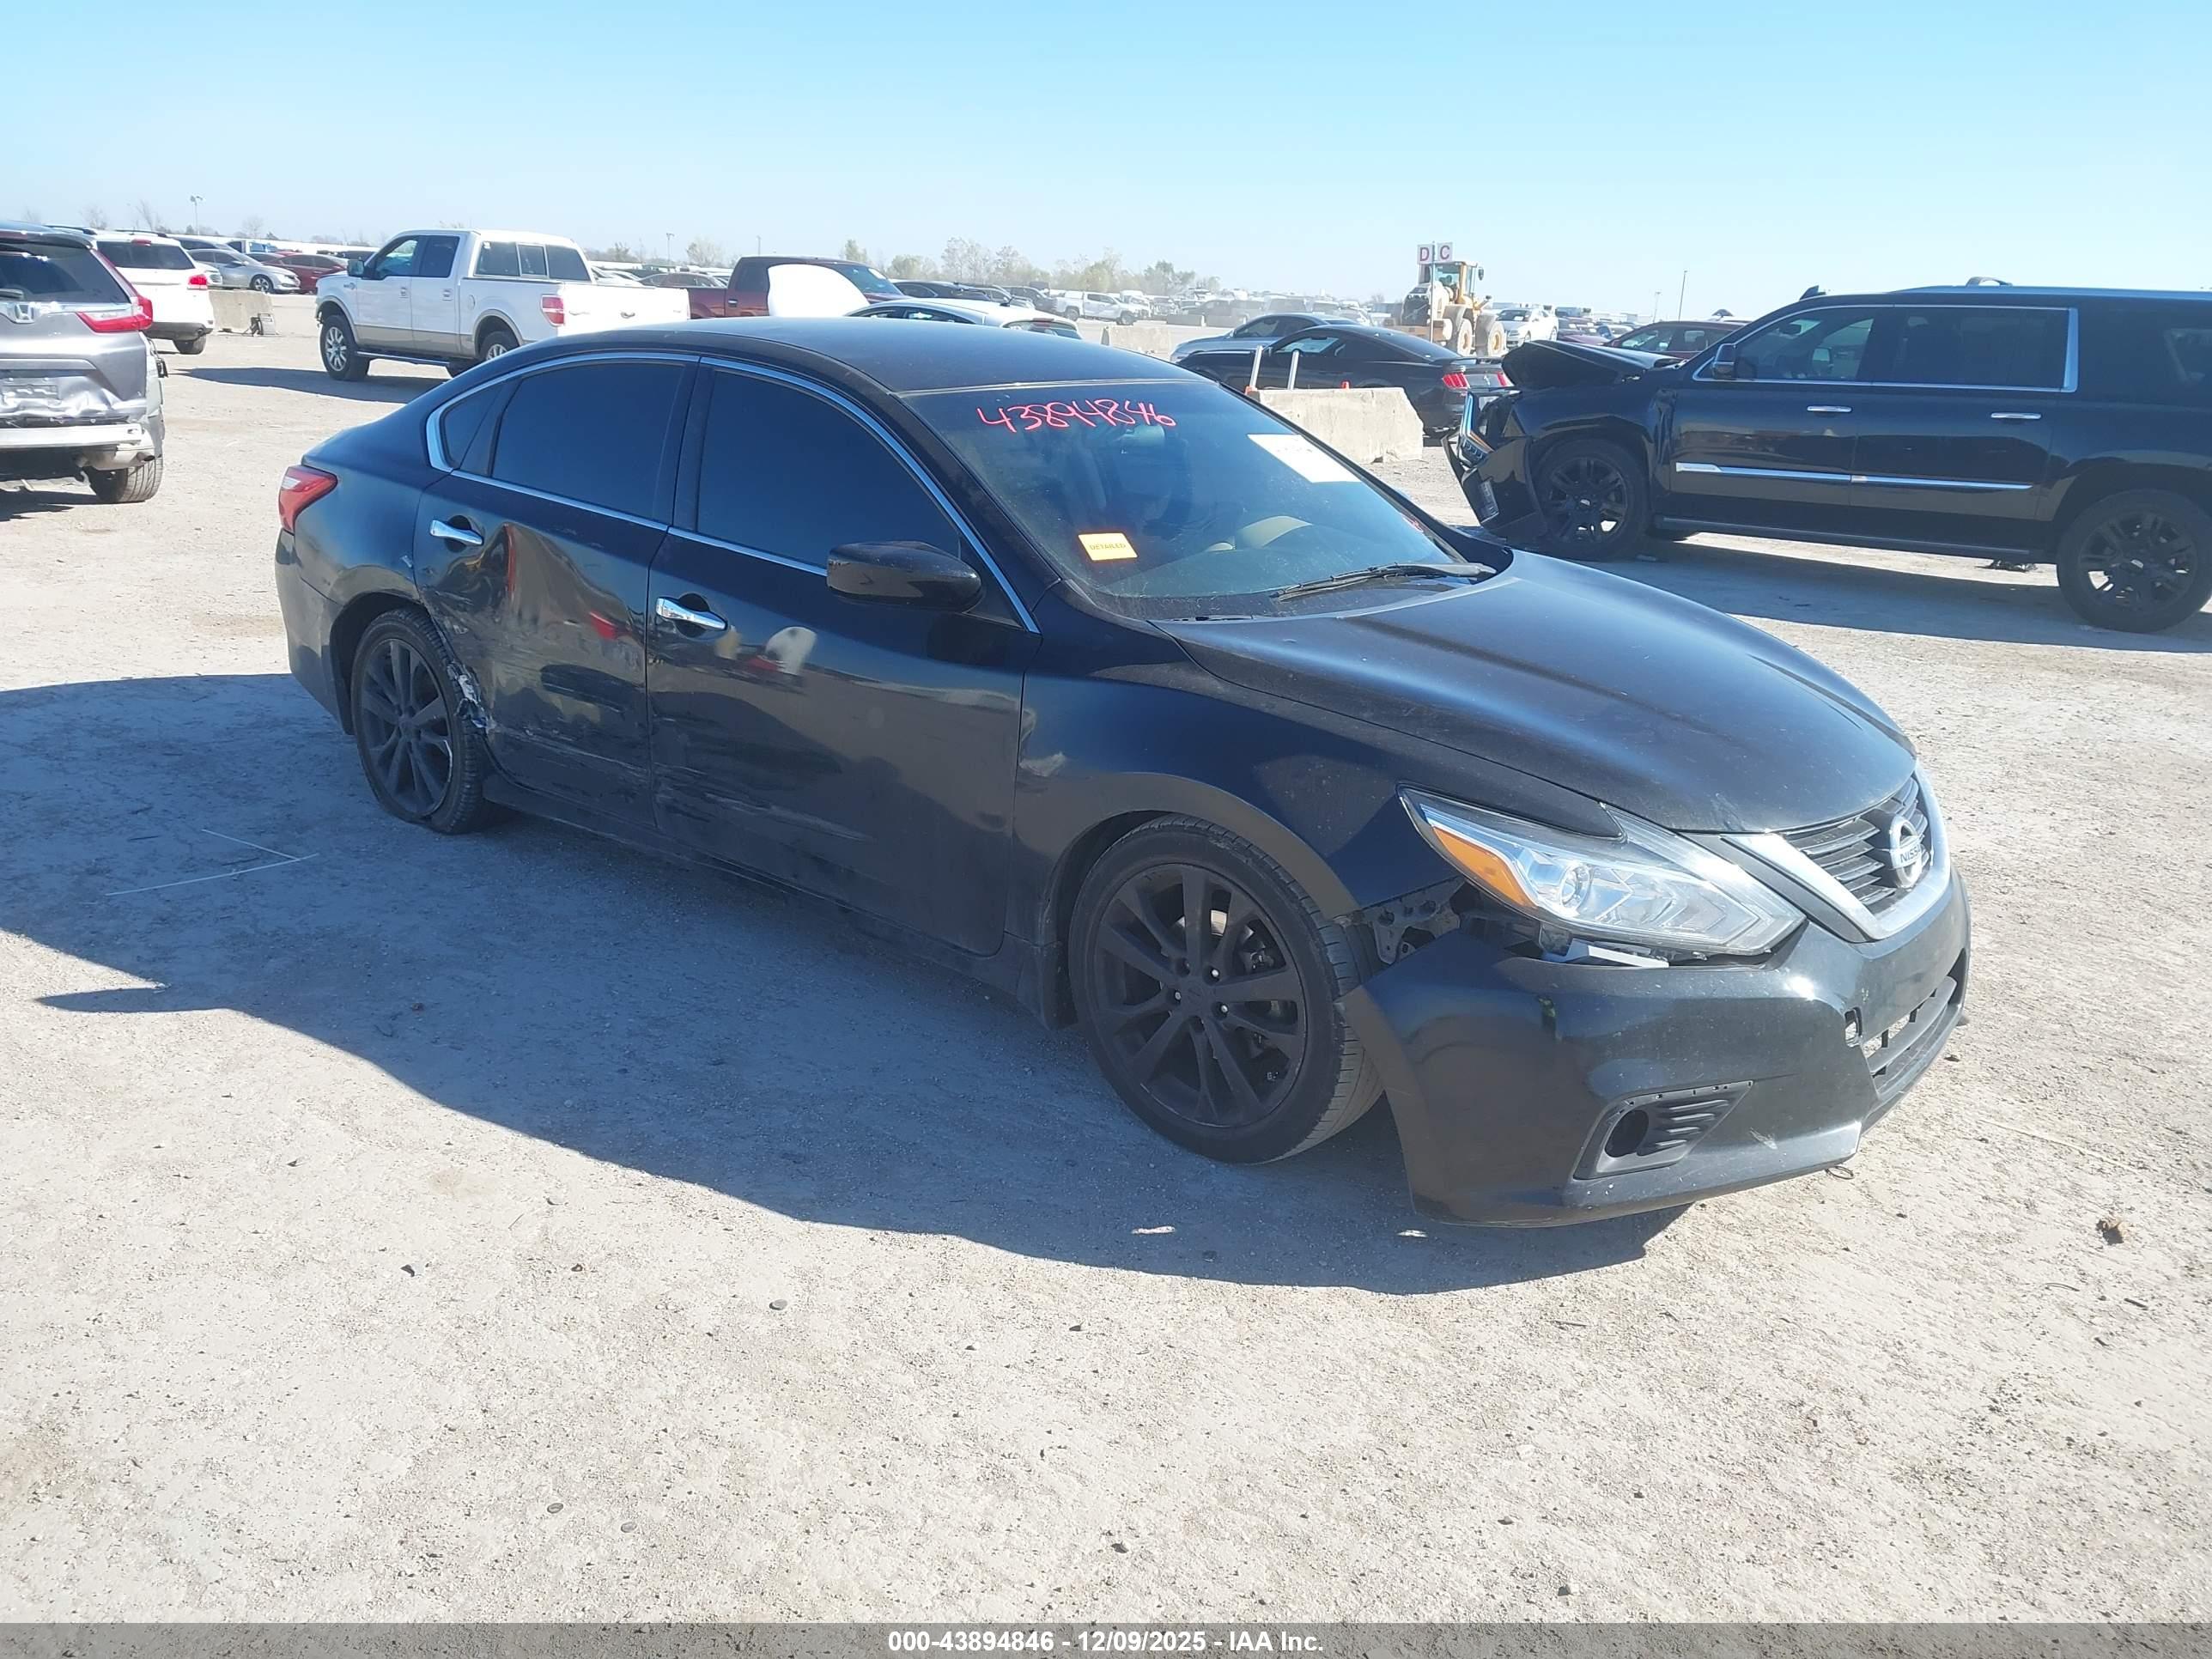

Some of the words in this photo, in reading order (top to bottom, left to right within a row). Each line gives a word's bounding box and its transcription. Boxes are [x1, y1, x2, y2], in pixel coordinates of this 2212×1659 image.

[1419, 246, 1430, 262] D
[1439, 245, 1450, 260] C
[976, 398, 1177, 434] 43894846
